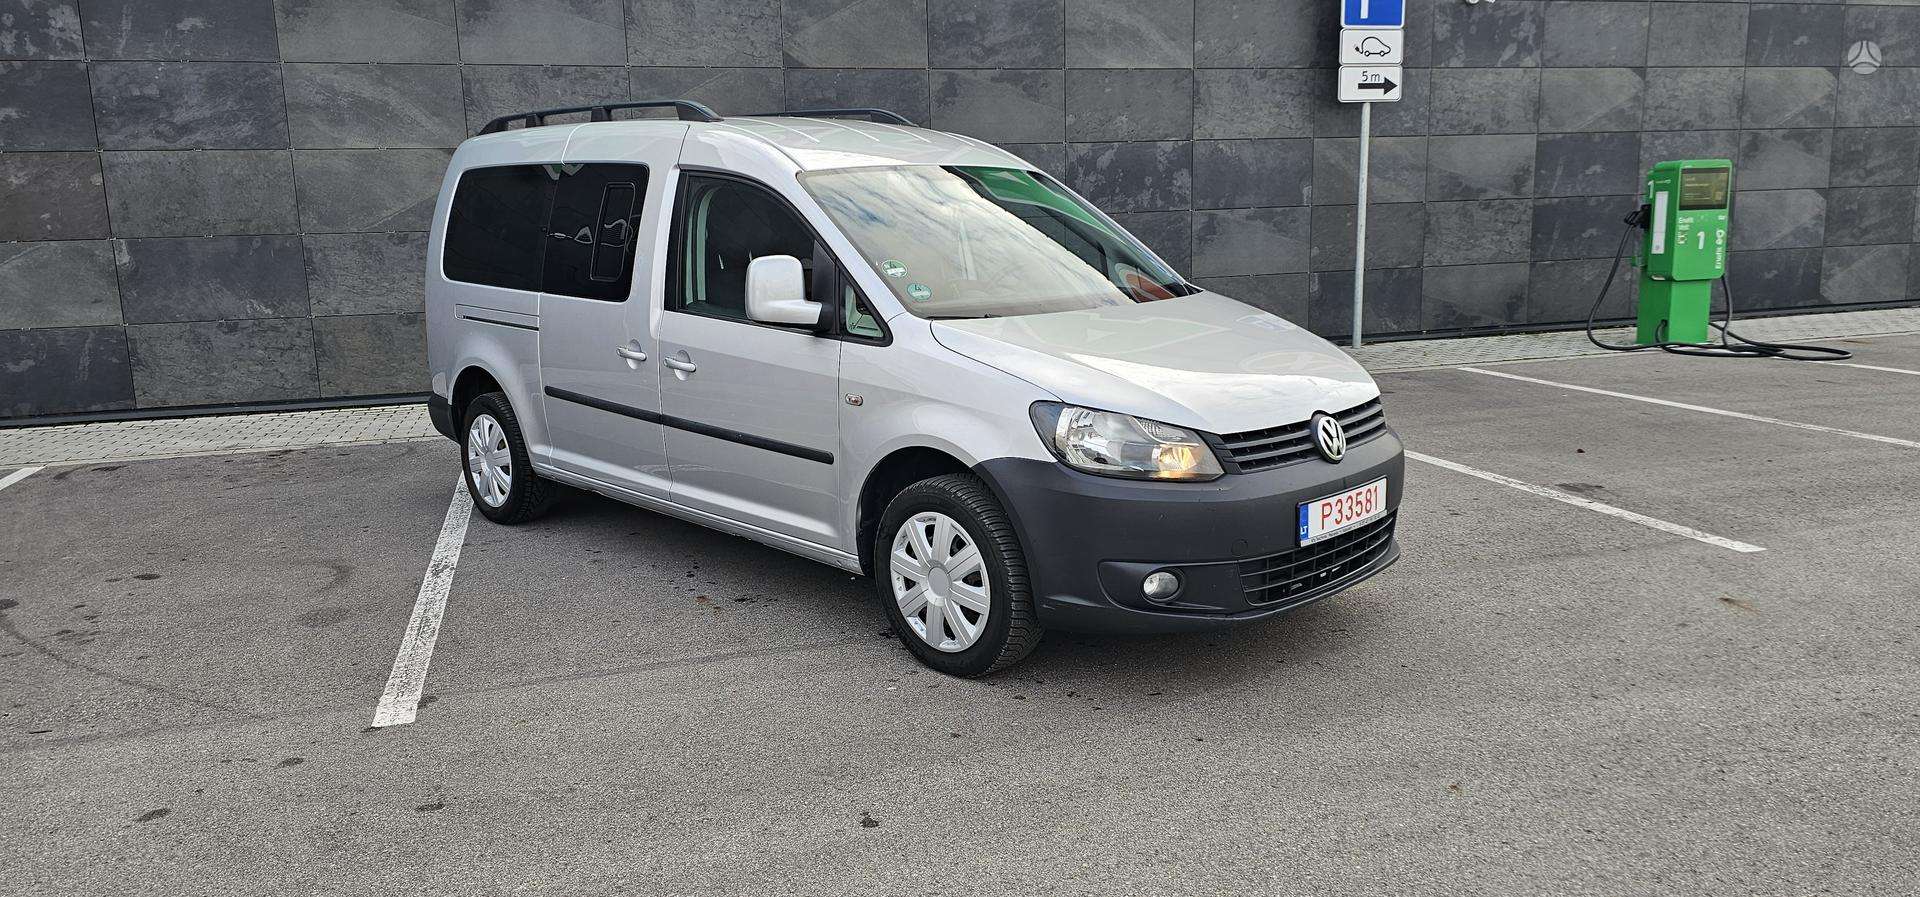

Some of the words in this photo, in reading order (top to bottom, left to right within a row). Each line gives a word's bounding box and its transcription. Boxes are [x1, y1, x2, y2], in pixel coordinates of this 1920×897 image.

[1361, 71, 1368, 82] 5
[1370, 73, 1380, 82] m
[1697, 231, 1705, 250] 1
[1321, 485, 1378, 530] P33581
